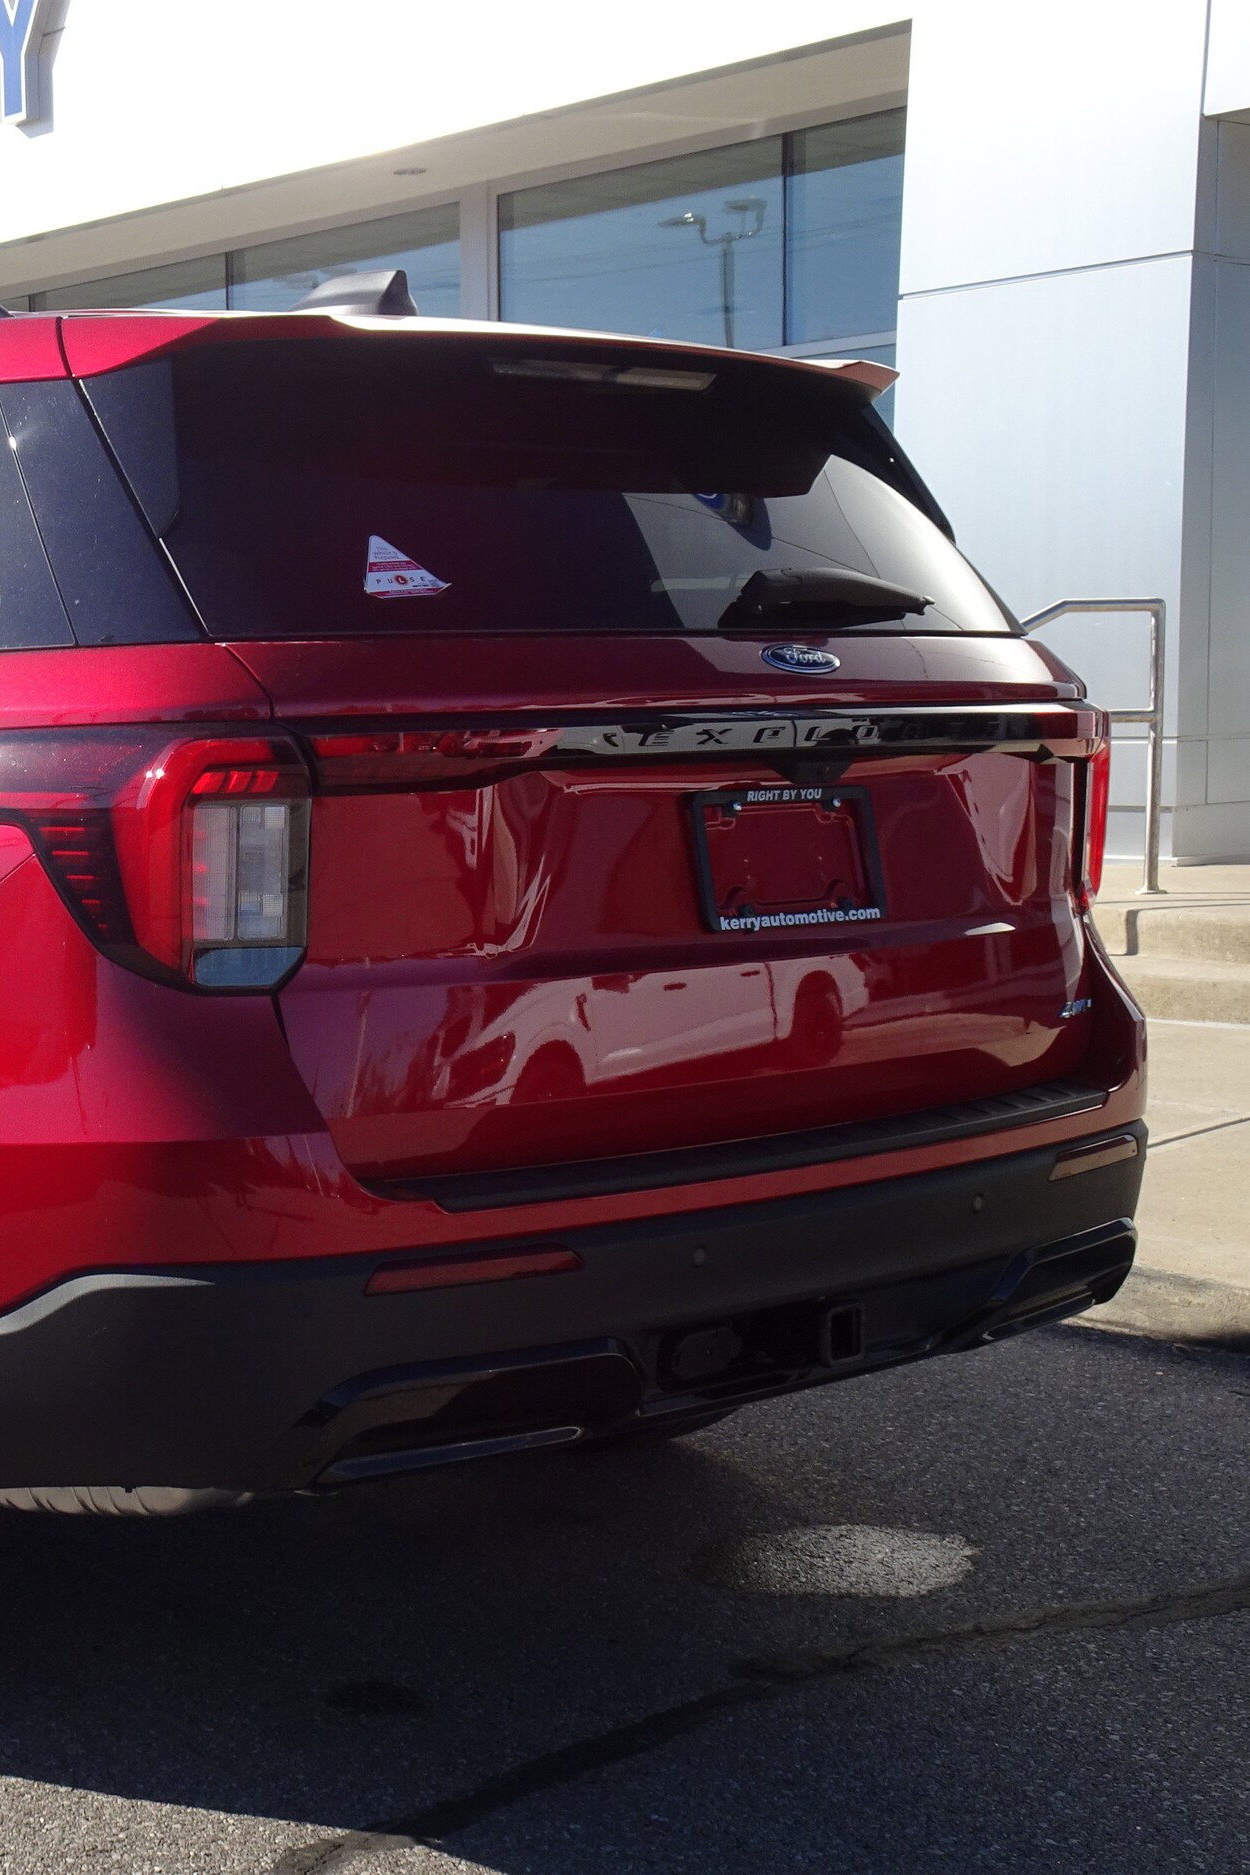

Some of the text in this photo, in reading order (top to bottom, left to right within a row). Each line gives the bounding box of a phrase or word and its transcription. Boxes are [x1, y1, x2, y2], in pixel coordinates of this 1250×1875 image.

[747, 788, 822, 801] RIGHT BY YOU
[720, 907, 880, 932] kerryautomotive.com
